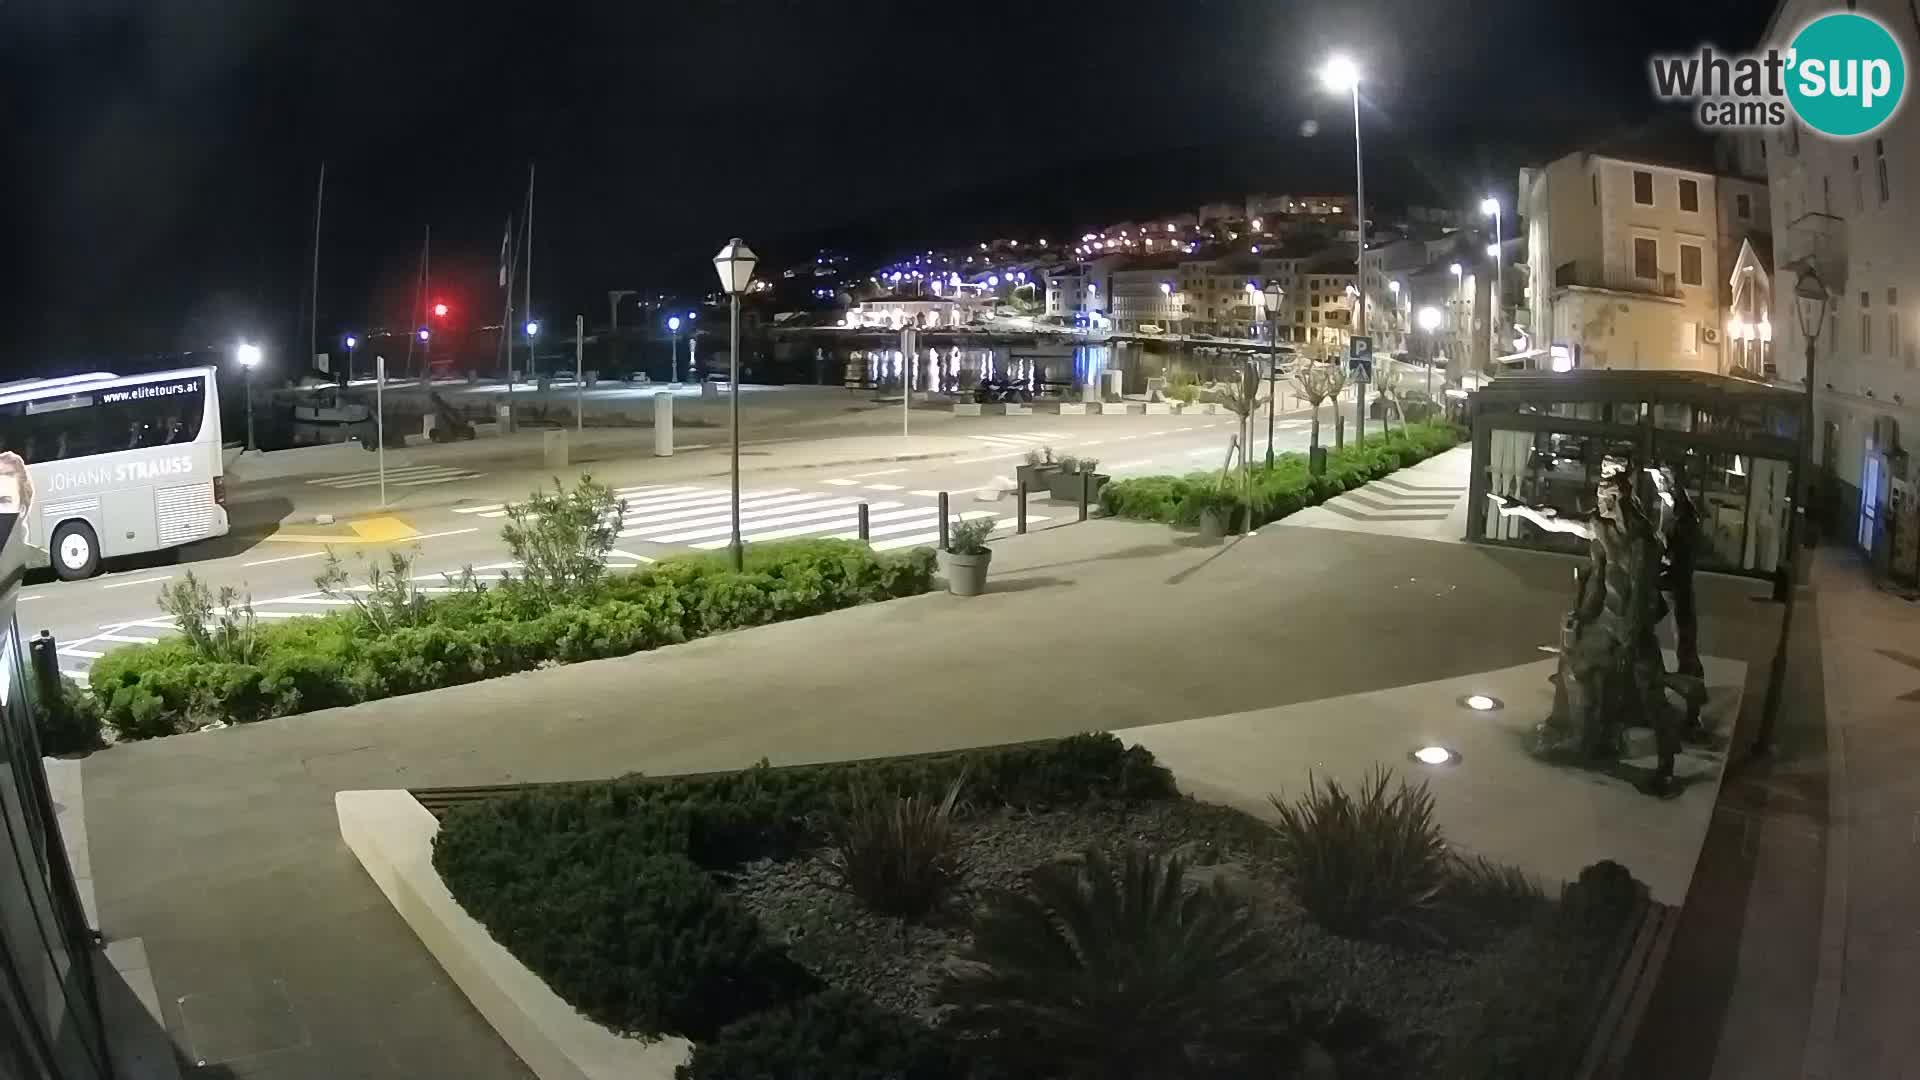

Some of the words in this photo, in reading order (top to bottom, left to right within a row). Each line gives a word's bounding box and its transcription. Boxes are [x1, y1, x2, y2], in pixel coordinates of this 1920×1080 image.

[1355, 340, 1368, 356] P
[103, 381, 198, 403] www.elitetours.at
[48, 471, 111, 492] JOHANN
[115, 456, 192, 481] STRAUSS
